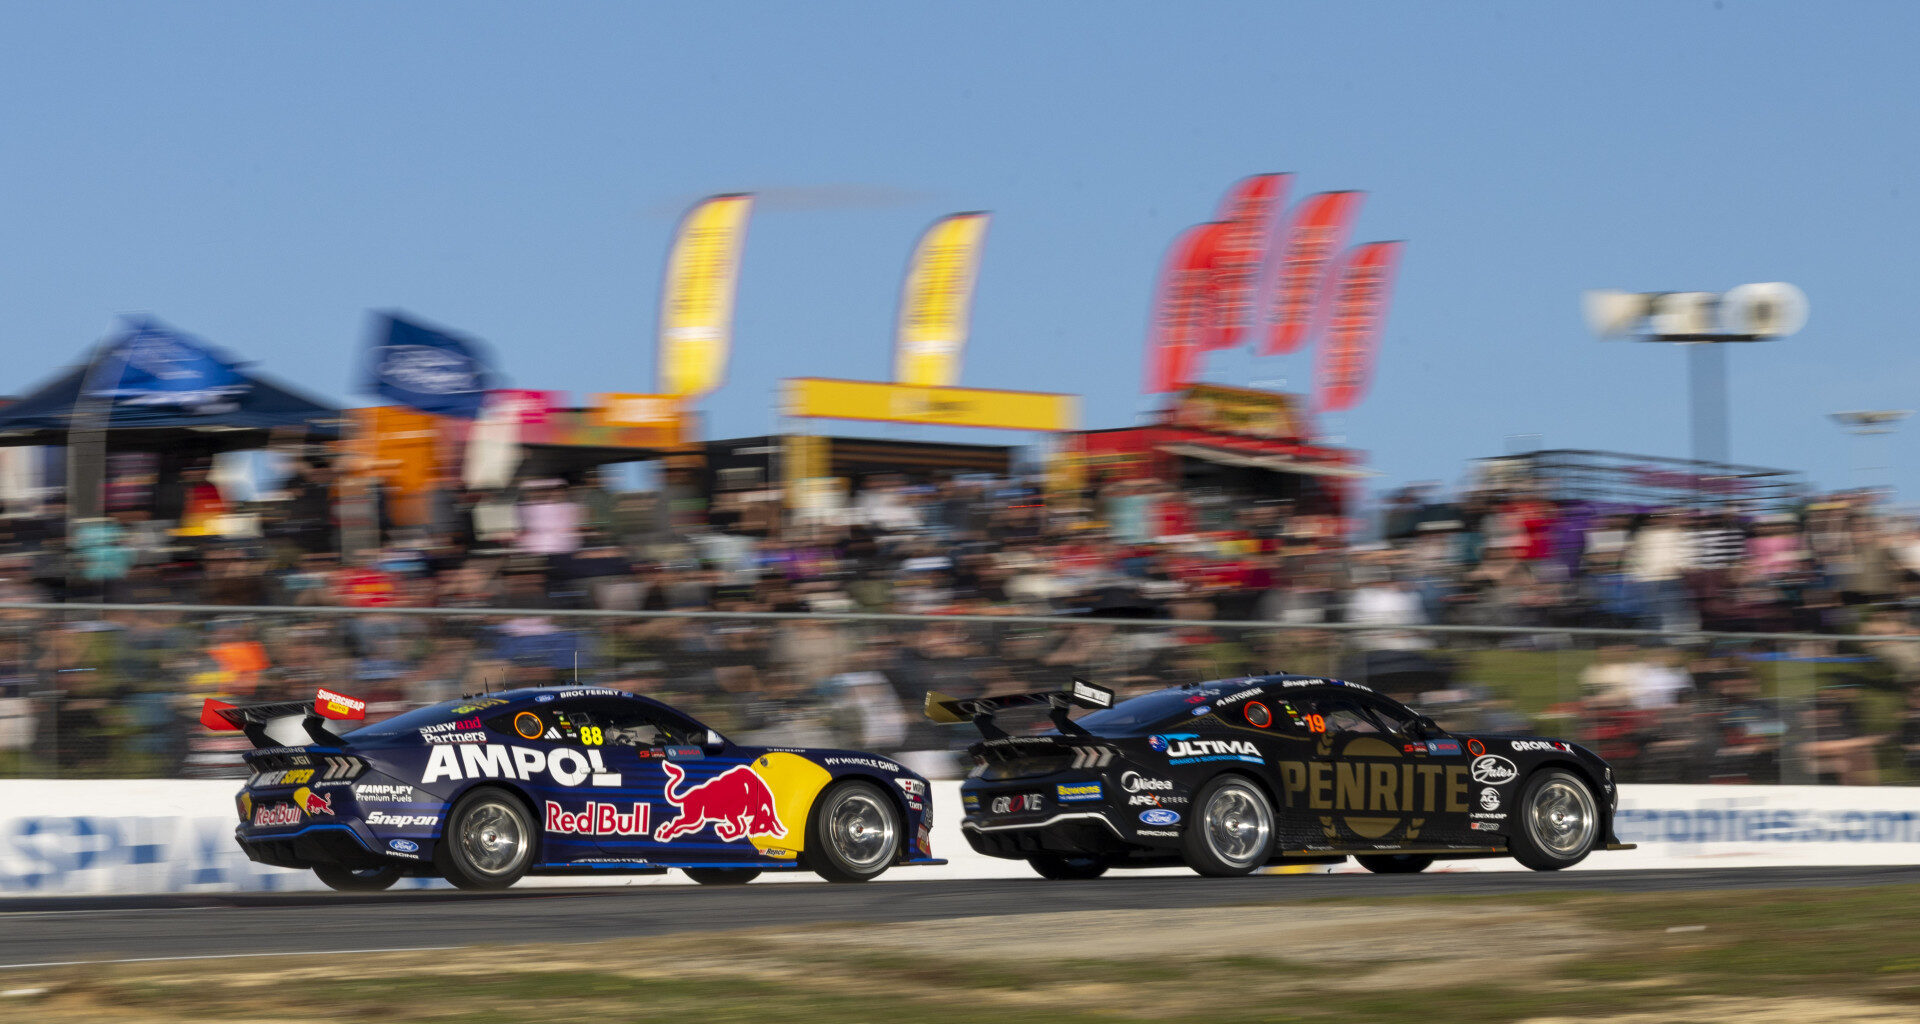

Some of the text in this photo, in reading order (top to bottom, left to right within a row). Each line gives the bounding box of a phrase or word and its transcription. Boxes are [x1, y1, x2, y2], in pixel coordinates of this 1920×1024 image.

[317, 689, 365, 711] SUPERCHEAP
[560, 689, 619, 698] BROC FEENEY
[1224, 687, 1264, 704] AUTODESK
[1305, 713, 1326, 733] 19
[422, 731, 487, 743] Partners
[580, 726, 603, 746] 88
[1166, 740, 1263, 757] ULTIMA
[421, 744, 622, 787] AMPOL
[825, 758, 900, 773] MY MUSCLE CHEF
[1474, 758, 1515, 780] Gates
[366, 785, 414, 795] AMPLIFY
[1057, 785, 1101, 795] Bowens
[1278, 760, 1470, 813] PENRITE
[356, 794, 412, 803] Premium Fuels
[992, 794, 1043, 814] GROVE
[1128, 793, 1162, 806] APEX
[1480, 794, 1501, 803] ACL
[254, 802, 302, 827] Red Bull
[365, 812, 440, 828] Snap-on
[546, 801, 651, 836] Red Bull
[1144, 811, 1176, 824] Ford
[1136, 830, 1180, 838] RACING
[393, 841, 416, 852] Ford
[766, 848, 786, 856] Repco
[385, 850, 419, 860] RACING
